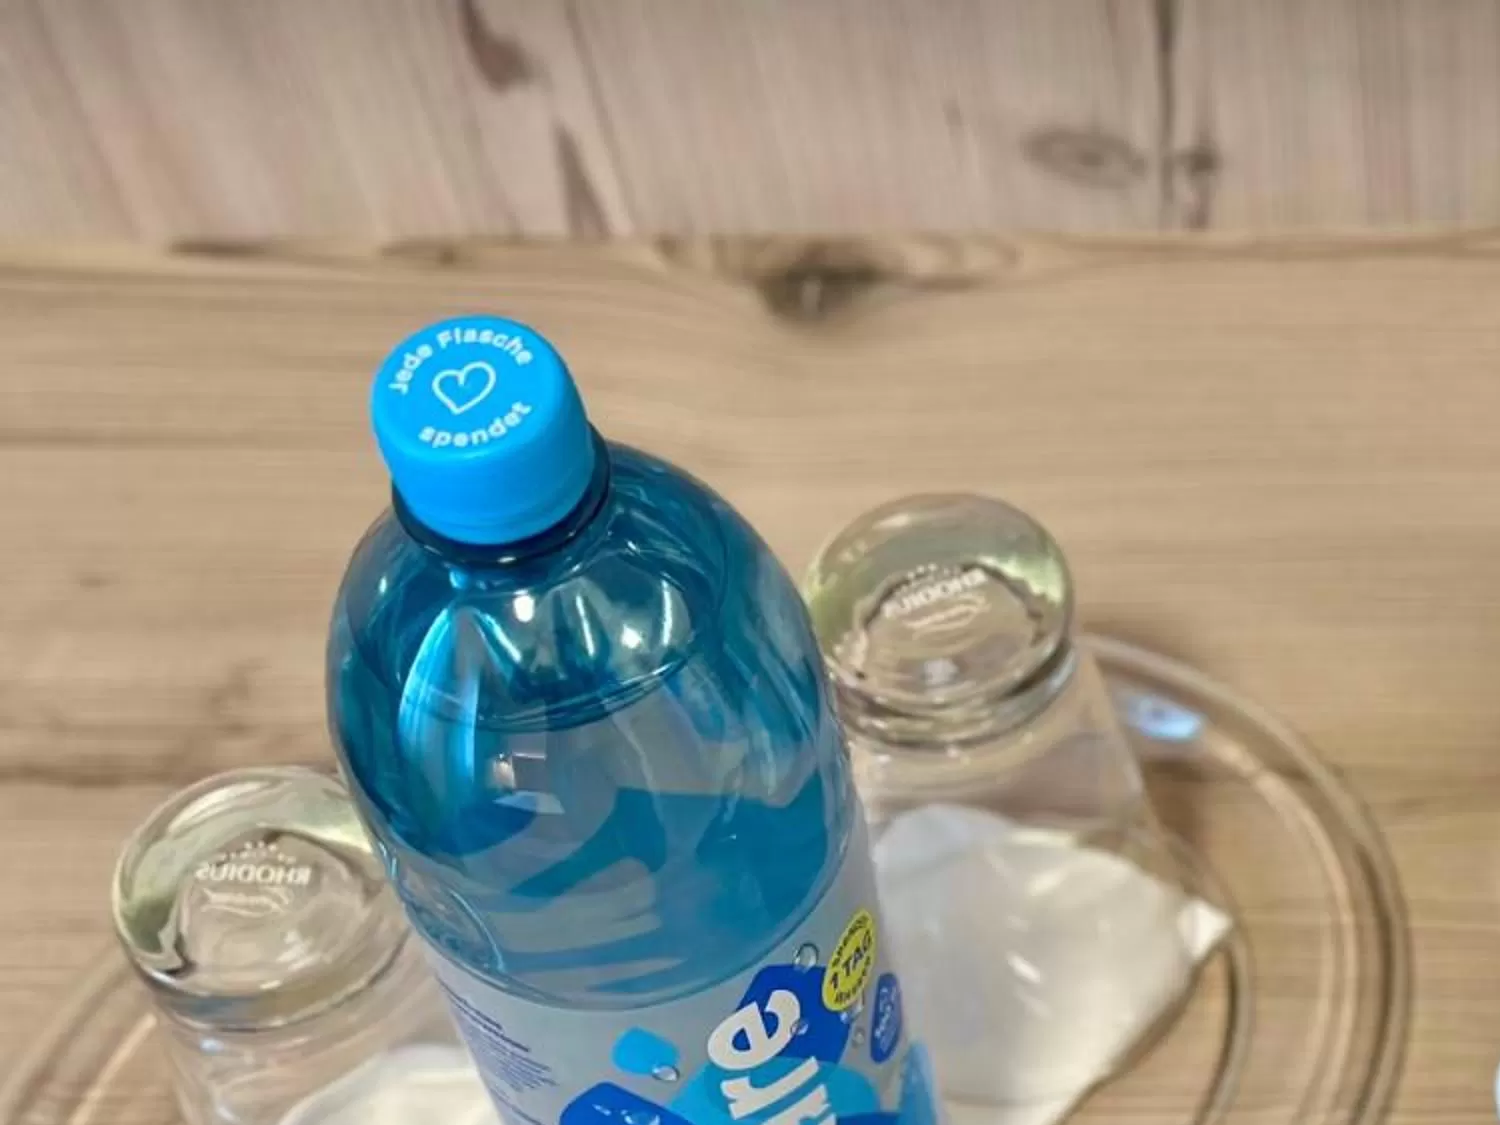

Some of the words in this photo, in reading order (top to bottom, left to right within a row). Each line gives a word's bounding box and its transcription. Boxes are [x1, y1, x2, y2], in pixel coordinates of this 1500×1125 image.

[388, 343, 434, 396] Jede
[436, 327, 534, 367] Flasche
[418, 401, 533, 449] spendet
